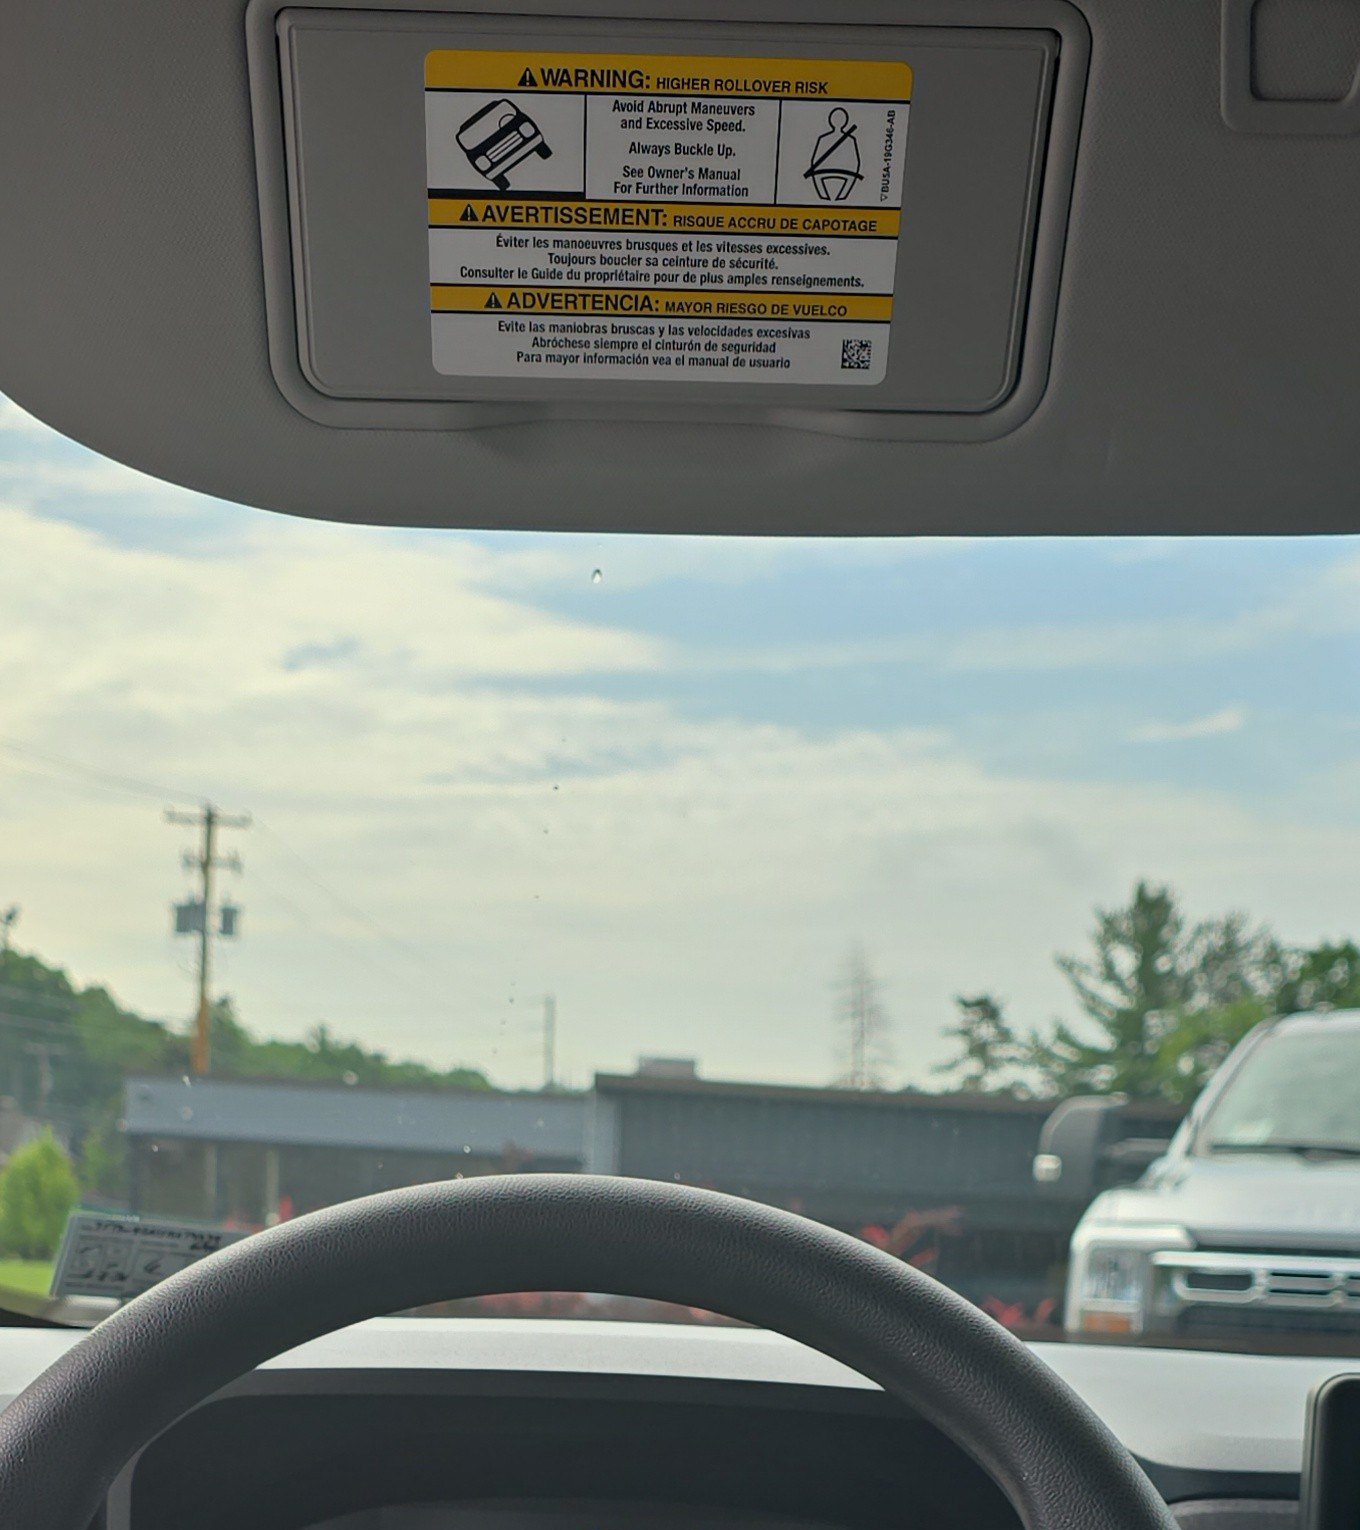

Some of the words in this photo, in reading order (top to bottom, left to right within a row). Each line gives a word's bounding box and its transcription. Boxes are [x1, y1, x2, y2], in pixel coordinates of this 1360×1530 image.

[541, 68, 651, 90] WARNING:
[656, 77, 710, 93] HIGHER
[714, 78, 791, 94] ROLLOVER
[795, 81, 828, 95] RISK
[612, 99, 644, 115] Avoid
[647, 101, 688, 119] Abrupt
[691, 102, 755, 117] Maneuvers
[621, 116, 643, 131] and
[646, 117, 703, 132] Excessive
[706, 118, 746, 135] Speed.
[629, 141, 671, 158] Always
[675, 142, 713, 157] Buckle
[716, 143, 736, 159] Up.
[623, 166, 643, 180] See
[647, 166, 694, 180] Owner's
[698, 167, 741, 181] Manual
[614, 182, 632, 196] For
[635, 183, 680, 197] Further
[681, 184, 749, 198] Information
[482, 206, 668, 227] AVERTISSEMENT:
[674, 216, 723, 228] RISQUE
[728, 217, 778, 230] ACCRU
[782, 218, 799, 230] DE
[802, 218, 878, 233] CAPOTAGE
[496, 233, 530, 250] Éviter
[533, 236, 549, 250] les
[553, 239, 623, 252] manoeuvres
[626, 238, 678, 255] brusques
[681, 240, 693, 252] et
[696, 240, 713, 253] les
[716, 241, 763, 255] vitesses
[766, 242, 830, 256] excessives.
[548, 252, 596, 270] Toujours
[600, 254, 642, 268] boucler
[646, 257, 658, 269] sa
[661, 255, 709, 269] ceinture
[713, 256, 726, 269] de
[729, 256, 779, 271] sécurité.
[460, 267, 513, 281] Consulter
[517, 268, 528, 281] le
[531, 268, 564, 282] Guide
[567, 269, 581, 282] du
[584, 270, 650, 286] propriétaire
[653, 274, 680, 288] pour
[683, 272, 697, 285] de
[700, 272, 724, 289] plus
[728, 273, 768, 290] amples
[771, 275, 865, 292] renseignements.
[507, 293, 660, 314] ADVERTENCIA:
[665, 302, 713, 315] MAYOR
[716, 303, 768, 316] RIESGO
[771, 304, 789, 316] DE
[792, 305, 848, 318] VUELCO
[498, 320, 525, 334] Evite
[528, 321, 546, 335] las
[549, 322, 607, 336] maniobras
[611, 323, 655, 337] bruscas
[658, 327, 665, 340] y
[668, 324, 684, 338] las
[687, 325, 754, 339] velocidades
[757, 326, 810, 340] excesivas
[532, 337, 590, 350] Abróchese
[593, 338, 639, 354] siempre
[642, 339, 653, 351] el
[655, 339, 702, 352] cinturón
[706, 339, 718, 353] de
[722, 339, 776, 355] seguridad
[517, 351, 543, 364] Para
[546, 354, 580, 368] mayor
[583, 351, 650, 366] información
[653, 356, 674, 367] vea
[677, 353, 687, 366] el
[689, 353, 731, 368] manual
[734, 354, 747, 368] de
[750, 355, 791, 369] usuario
